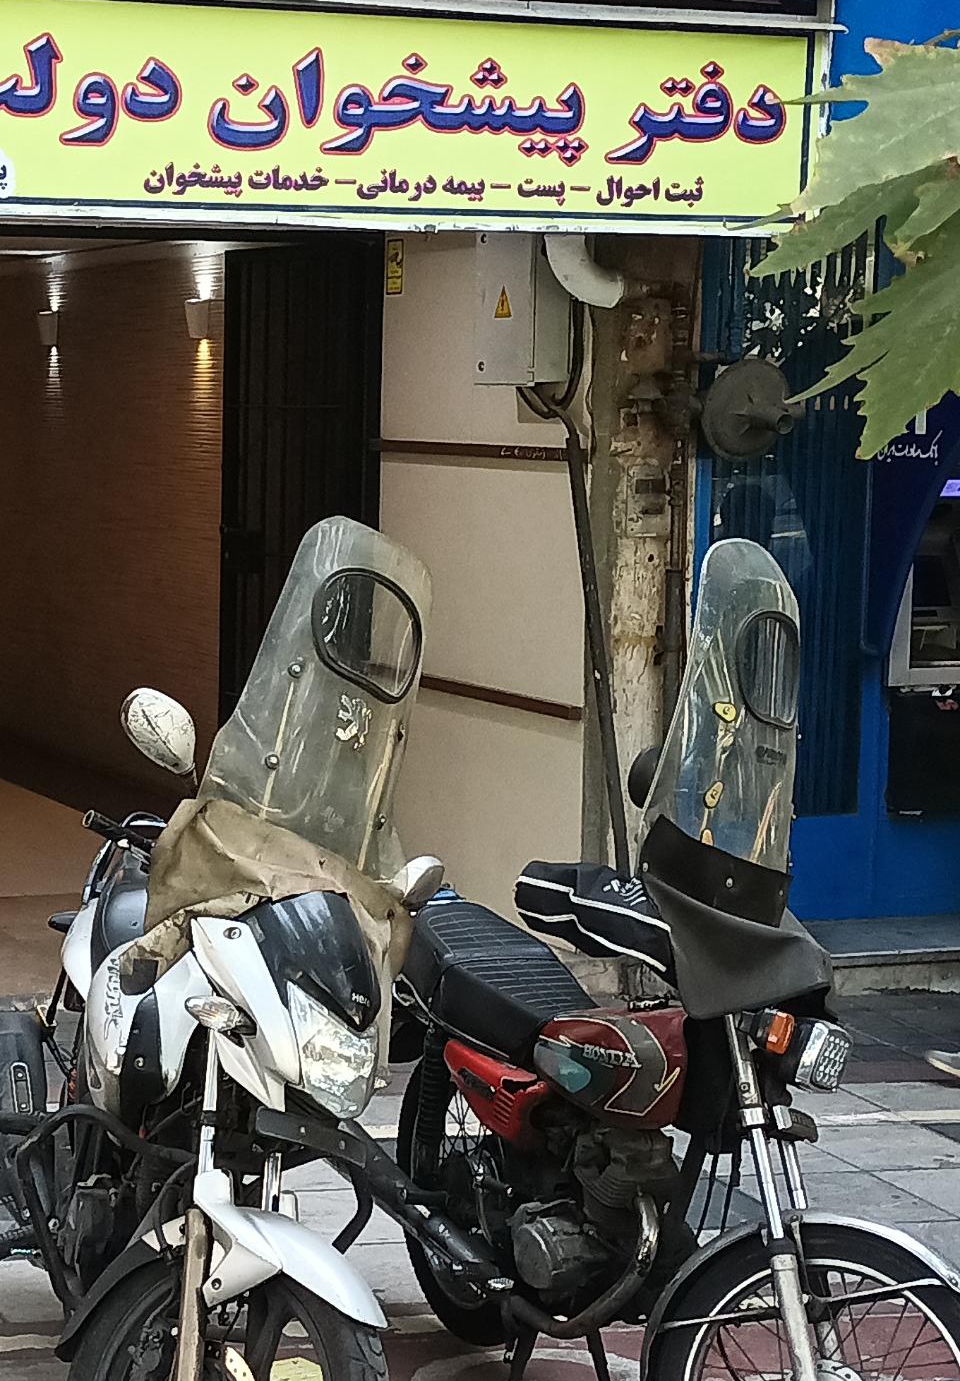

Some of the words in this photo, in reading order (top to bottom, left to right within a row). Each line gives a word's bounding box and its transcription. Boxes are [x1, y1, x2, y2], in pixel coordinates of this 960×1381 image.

[207, 47, 588, 167] پیشخوان
[605, 62, 788, 165] دفتر
[143, 162, 244, 198] پیشخوان
[247, 166, 329, 192] خدمات
[356, 168, 437, 201] درمانی
[441, 175, 486, 202] بیمه
[517, 177, 566, 206] پست
[596, 175, 661, 207] احوال
[664, 176, 704, 207] ثبت
[583, 1044, 642, 1068] HONDA
